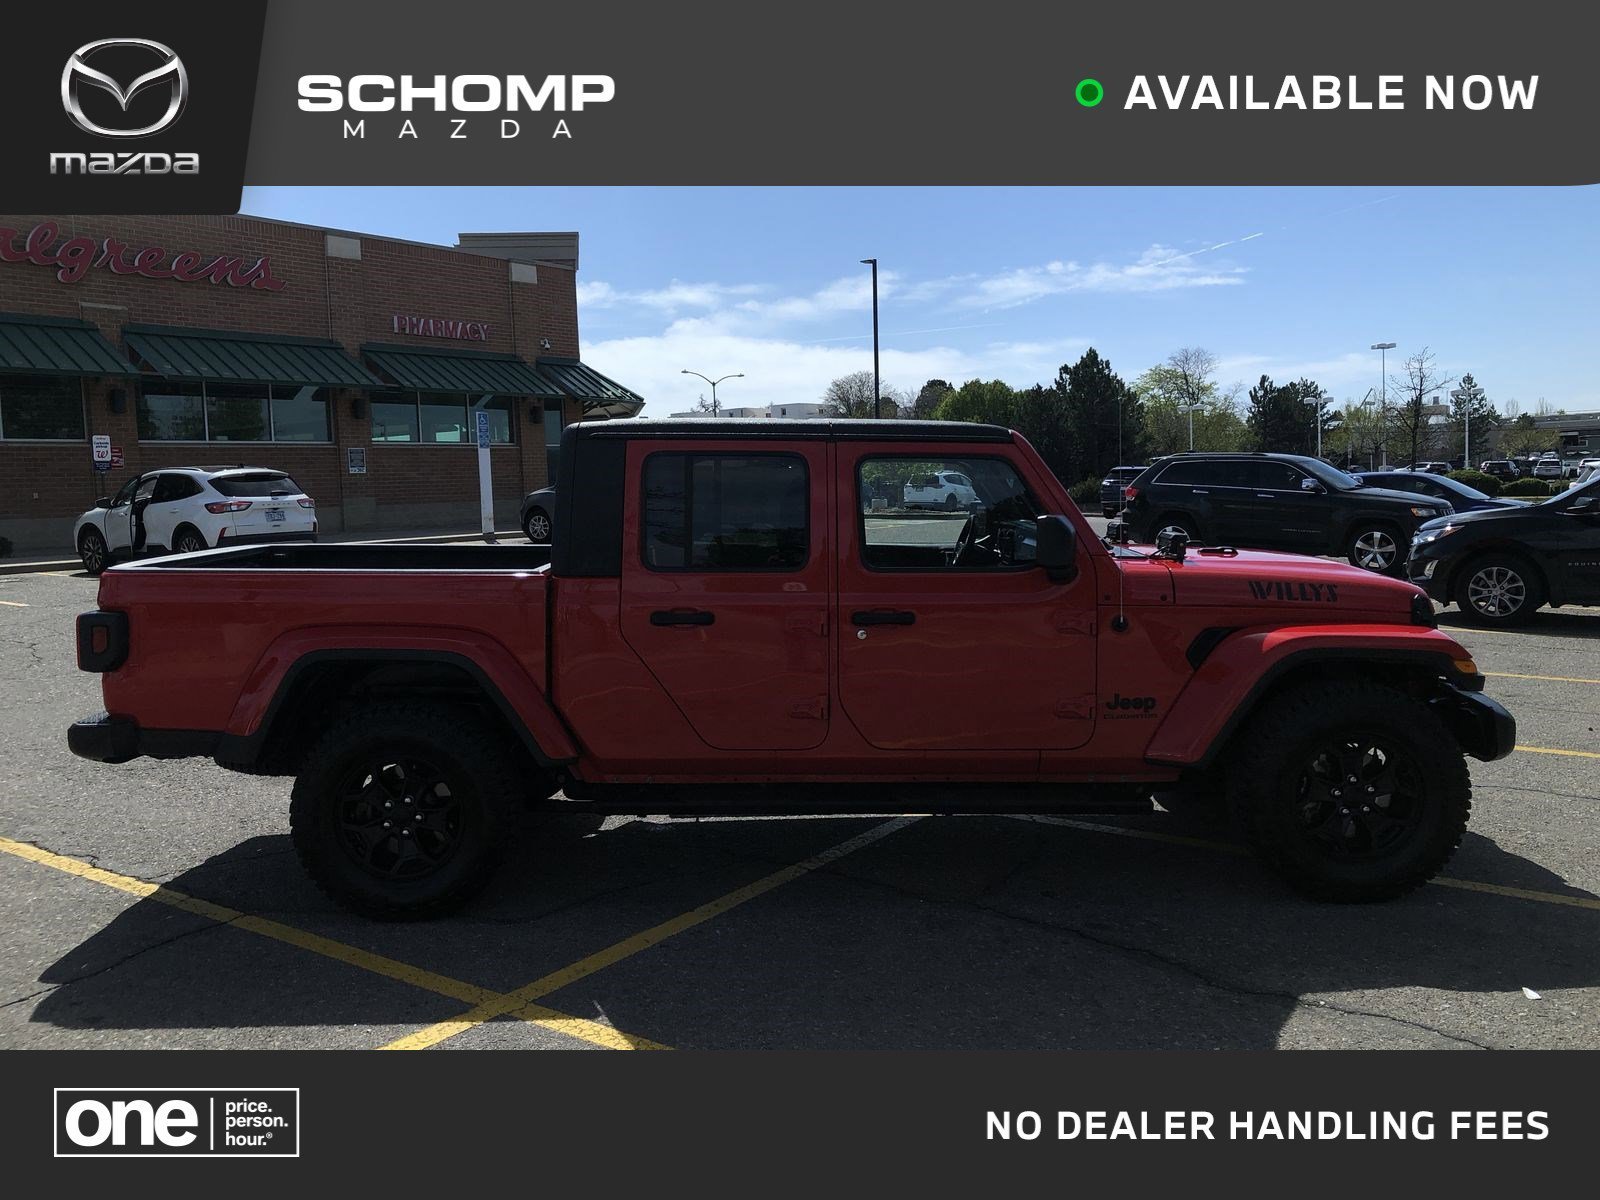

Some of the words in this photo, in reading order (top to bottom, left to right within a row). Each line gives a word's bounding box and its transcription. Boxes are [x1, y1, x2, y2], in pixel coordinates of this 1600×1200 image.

[393, 315, 490, 340] PHARMACY
[1248, 581, 1338, 602] WILLYS
[1105, 693, 1157, 713] Jeep
